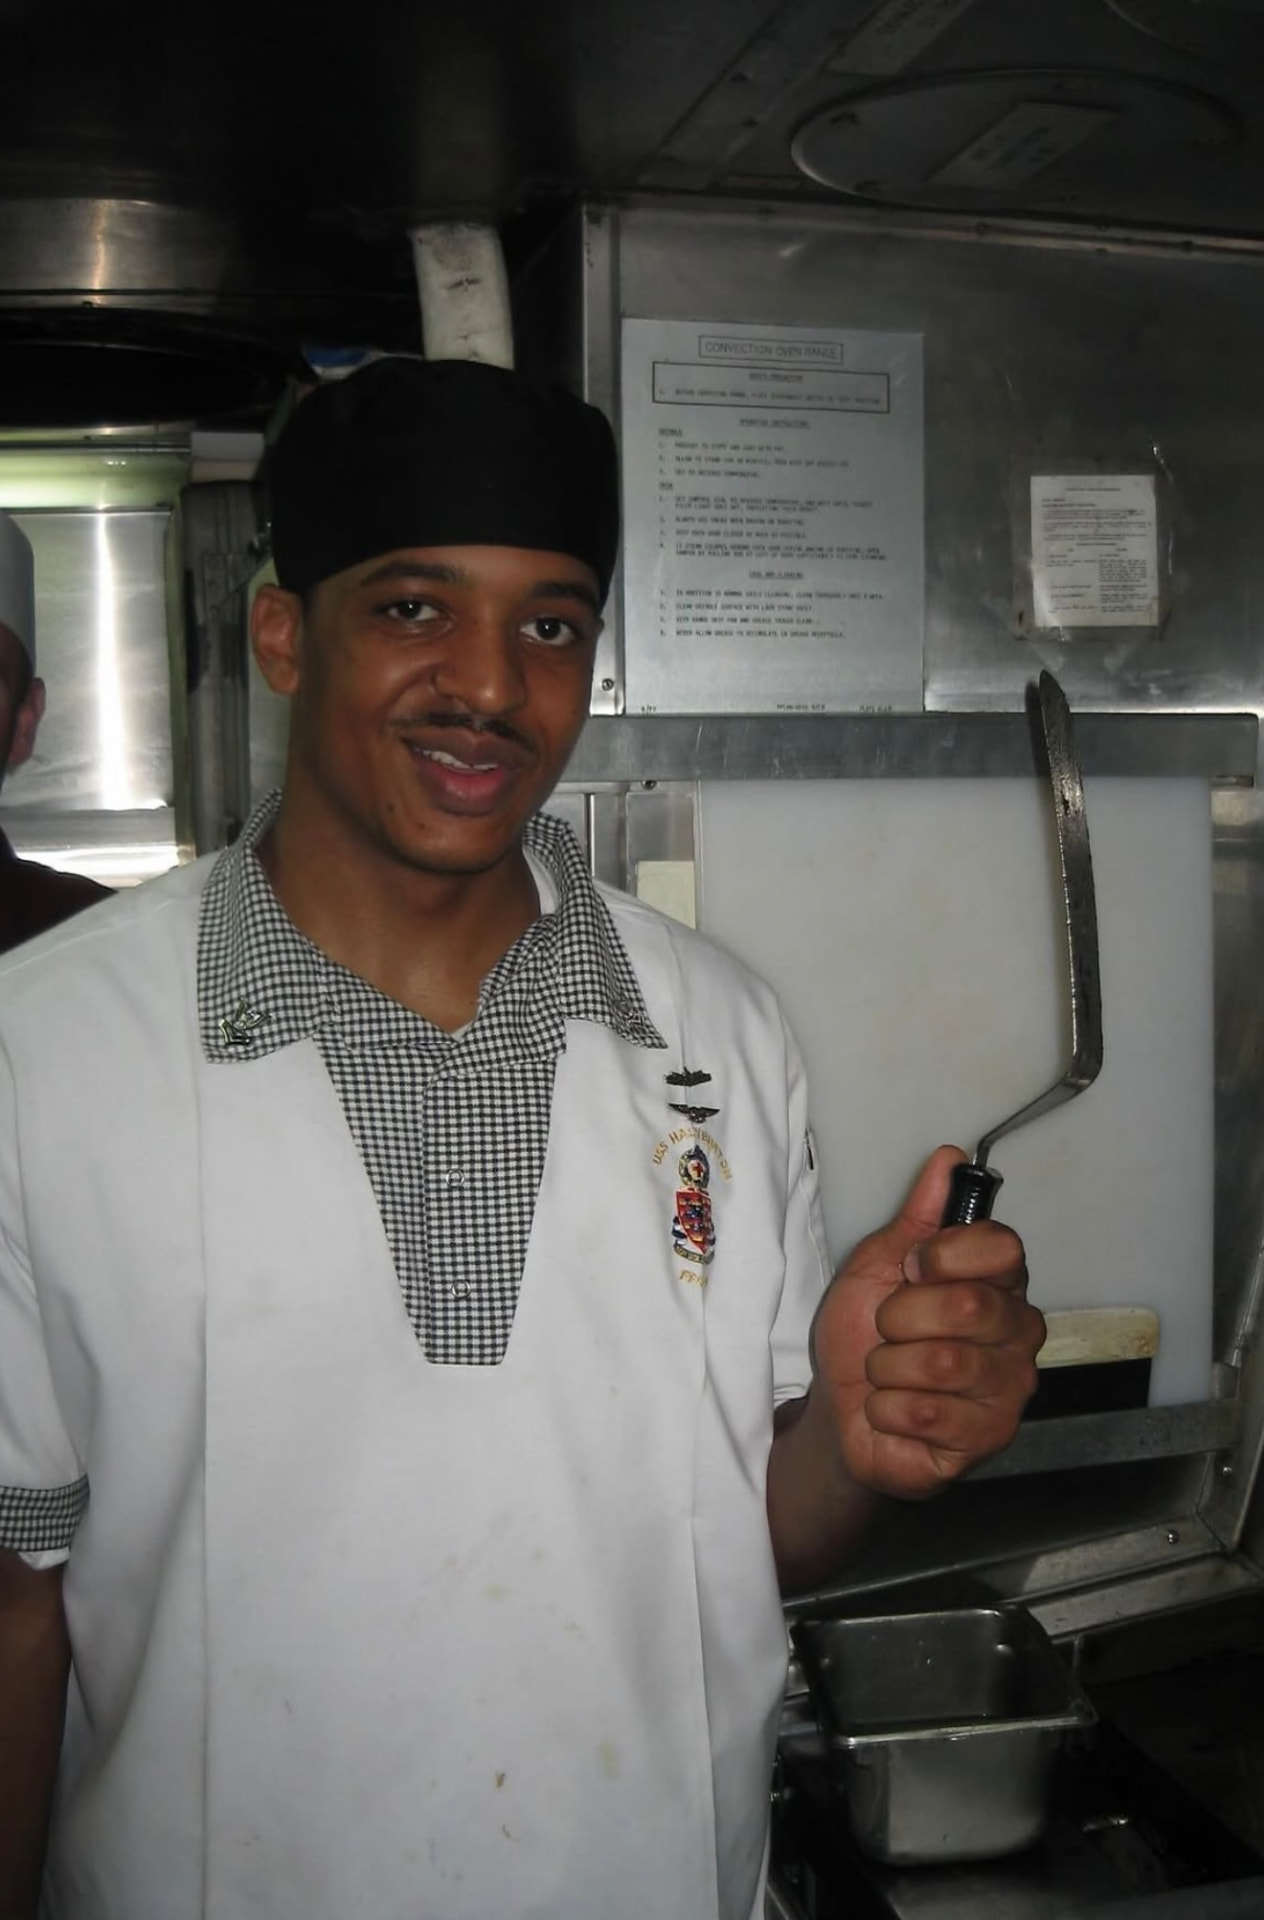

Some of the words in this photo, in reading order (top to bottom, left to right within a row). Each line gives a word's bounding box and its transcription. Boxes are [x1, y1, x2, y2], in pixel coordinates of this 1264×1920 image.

[704, 341, 774, 356] CONVECTION
[775, 345, 802, 357] OVEN
[804, 346, 838, 359] RANGE
[652, 1142, 669, 1165] USS
